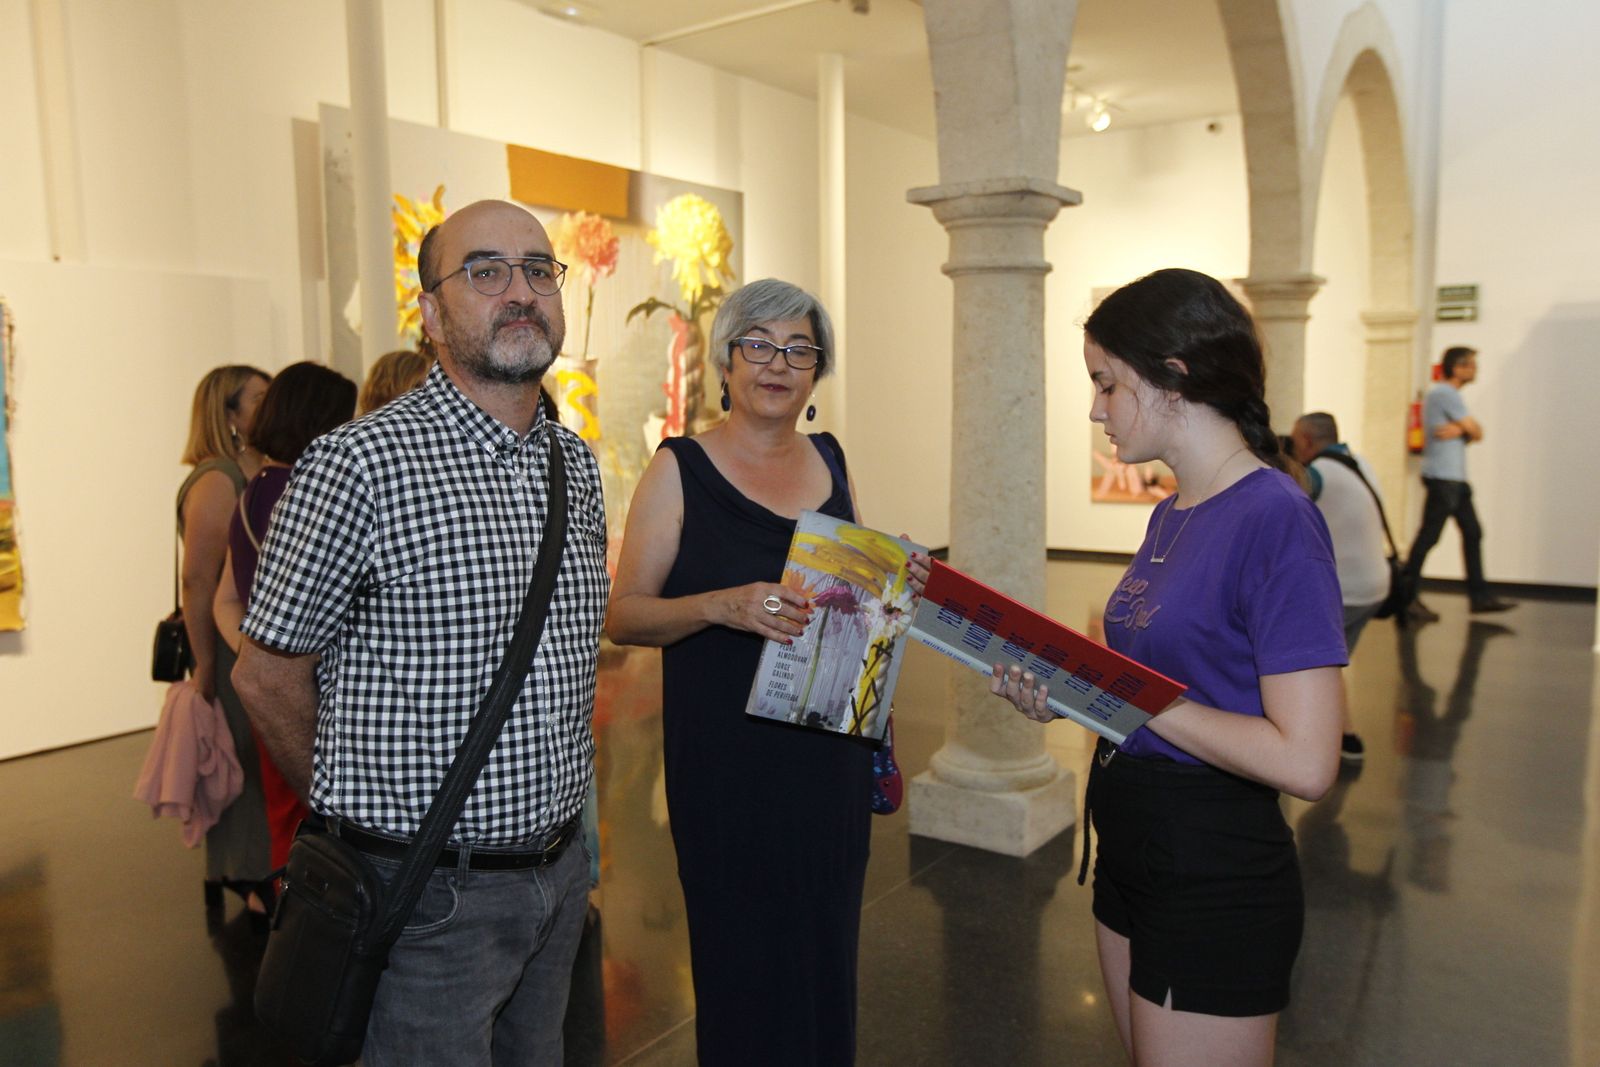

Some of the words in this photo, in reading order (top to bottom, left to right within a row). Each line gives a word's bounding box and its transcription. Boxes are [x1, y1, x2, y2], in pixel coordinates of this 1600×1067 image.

[937, 598, 969, 630] PEDRO
[960, 603, 1005, 654] ALMODOVAR
[1001, 632, 1036, 663] JORGE
[1028, 644, 1069, 680] GALINDO
[772, 669, 795, 680] GALINDO
[774, 661, 791, 671] JORGE
[1064, 664, 1104, 696] FLORES
[766, 689, 773, 697] DE
[768, 680, 788, 691] FLORES
[1095, 672, 1147, 713] PERIFERIA
[1086, 703, 1112, 721] DE
